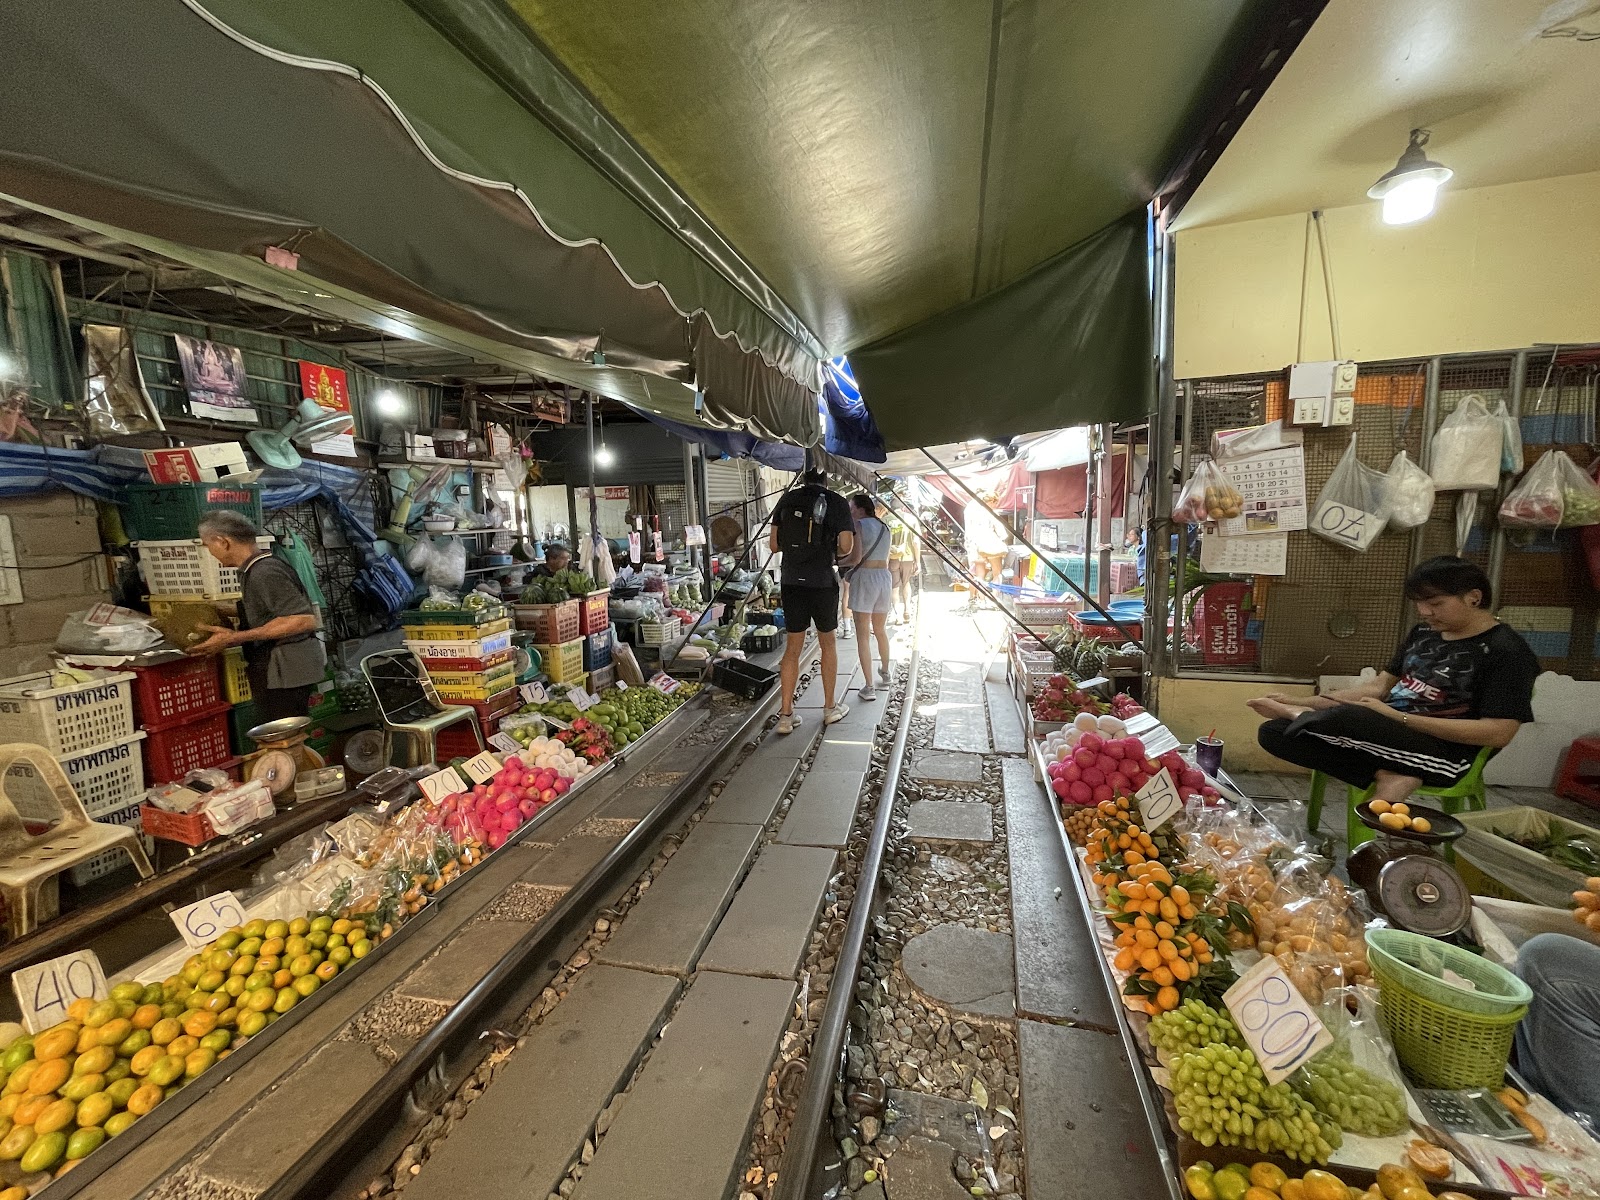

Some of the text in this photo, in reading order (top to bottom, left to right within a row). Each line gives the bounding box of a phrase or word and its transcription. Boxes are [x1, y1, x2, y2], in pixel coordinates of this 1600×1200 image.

[171, 455, 191, 482] LEO
[1321, 505, 1365, 541] 70
[1211, 625, 1225, 654] Kiwi
[1224, 603, 1239, 655] Crunch
[55, 684, 119, 712] เทพกมล
[526, 682, 545, 700] 15
[494, 734, 517, 752] 60
[68, 744, 130, 775] เทพกมล
[471, 758, 492, 775] 10
[424, 770, 460, 802] 20
[185, 894, 243, 938] 65
[34, 959, 96, 1012] 40
[1241, 976, 1310, 1056] 80
